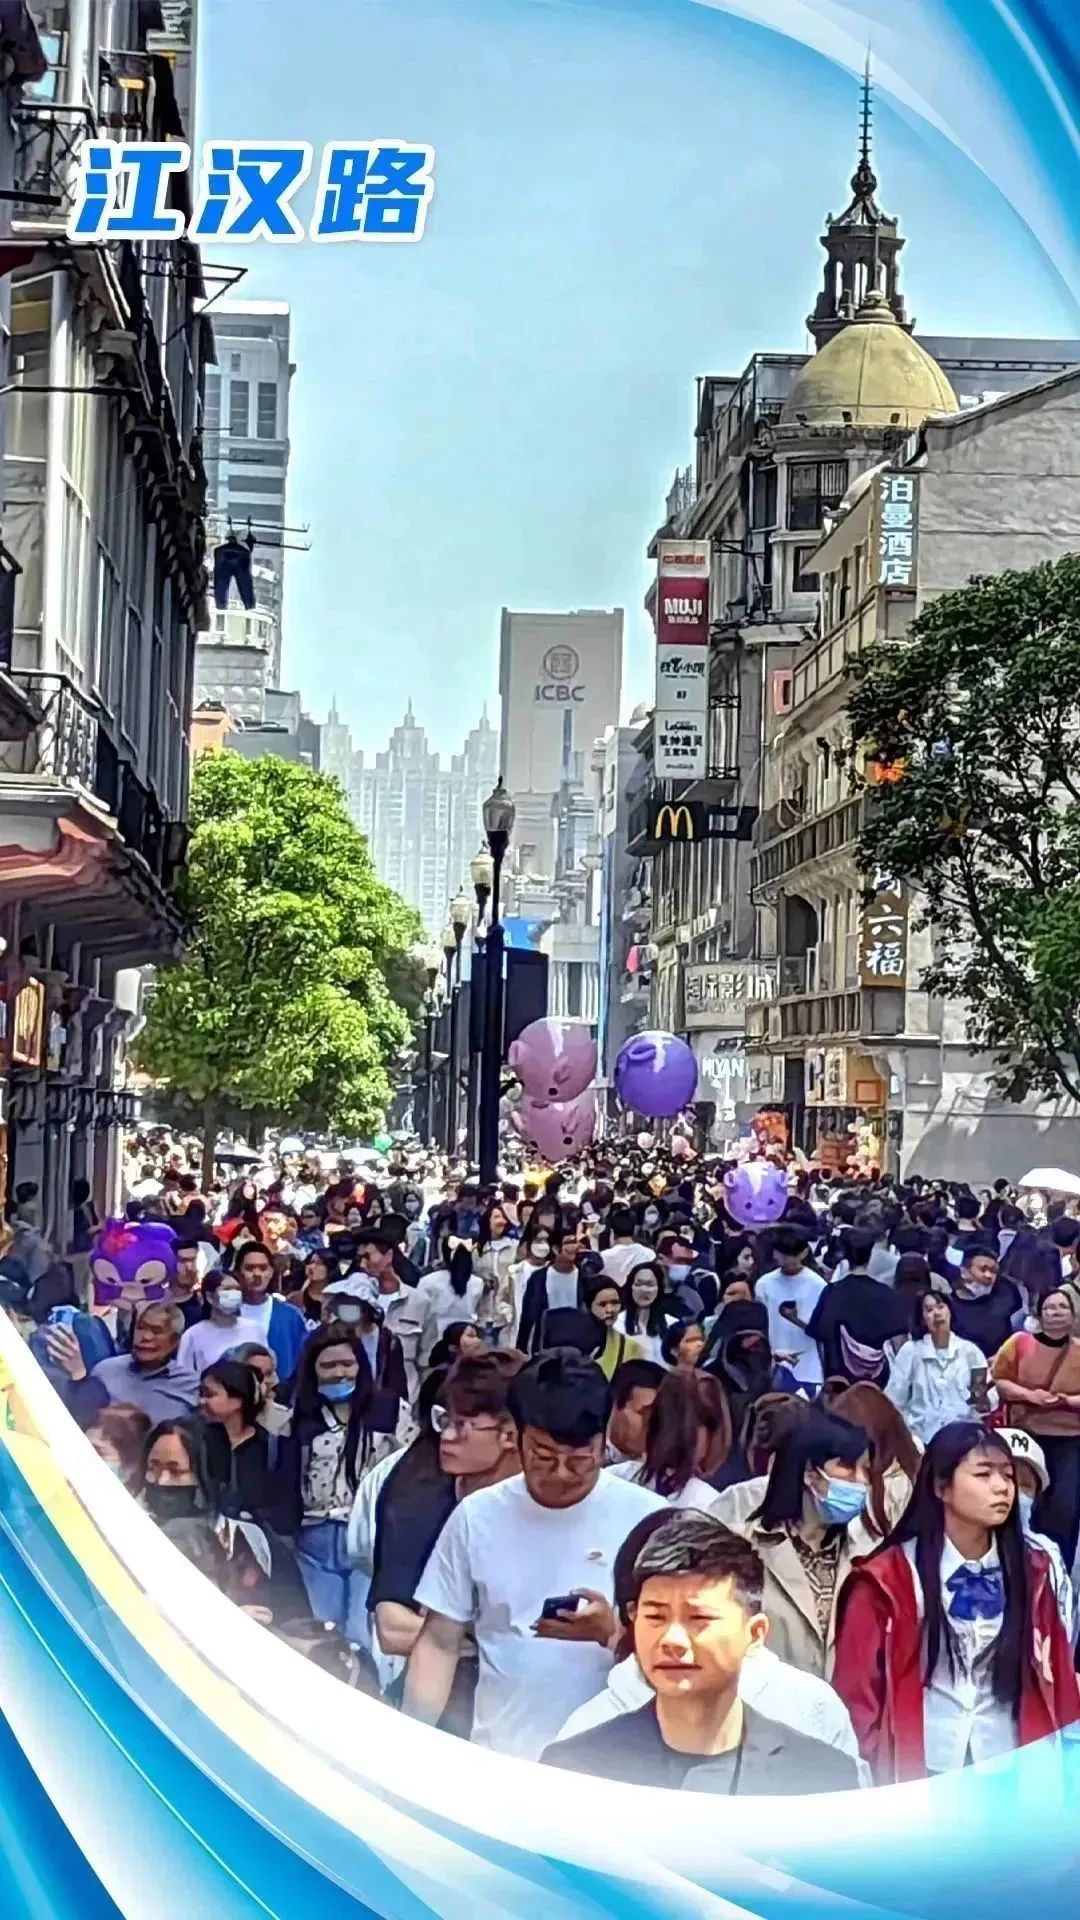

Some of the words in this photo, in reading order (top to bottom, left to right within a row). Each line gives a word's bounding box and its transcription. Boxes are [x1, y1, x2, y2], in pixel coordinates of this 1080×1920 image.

[879, 475, 913, 585] 泊曼酒店
[664, 598, 703, 616] MUJI
[535, 684, 586, 702] ICBC
